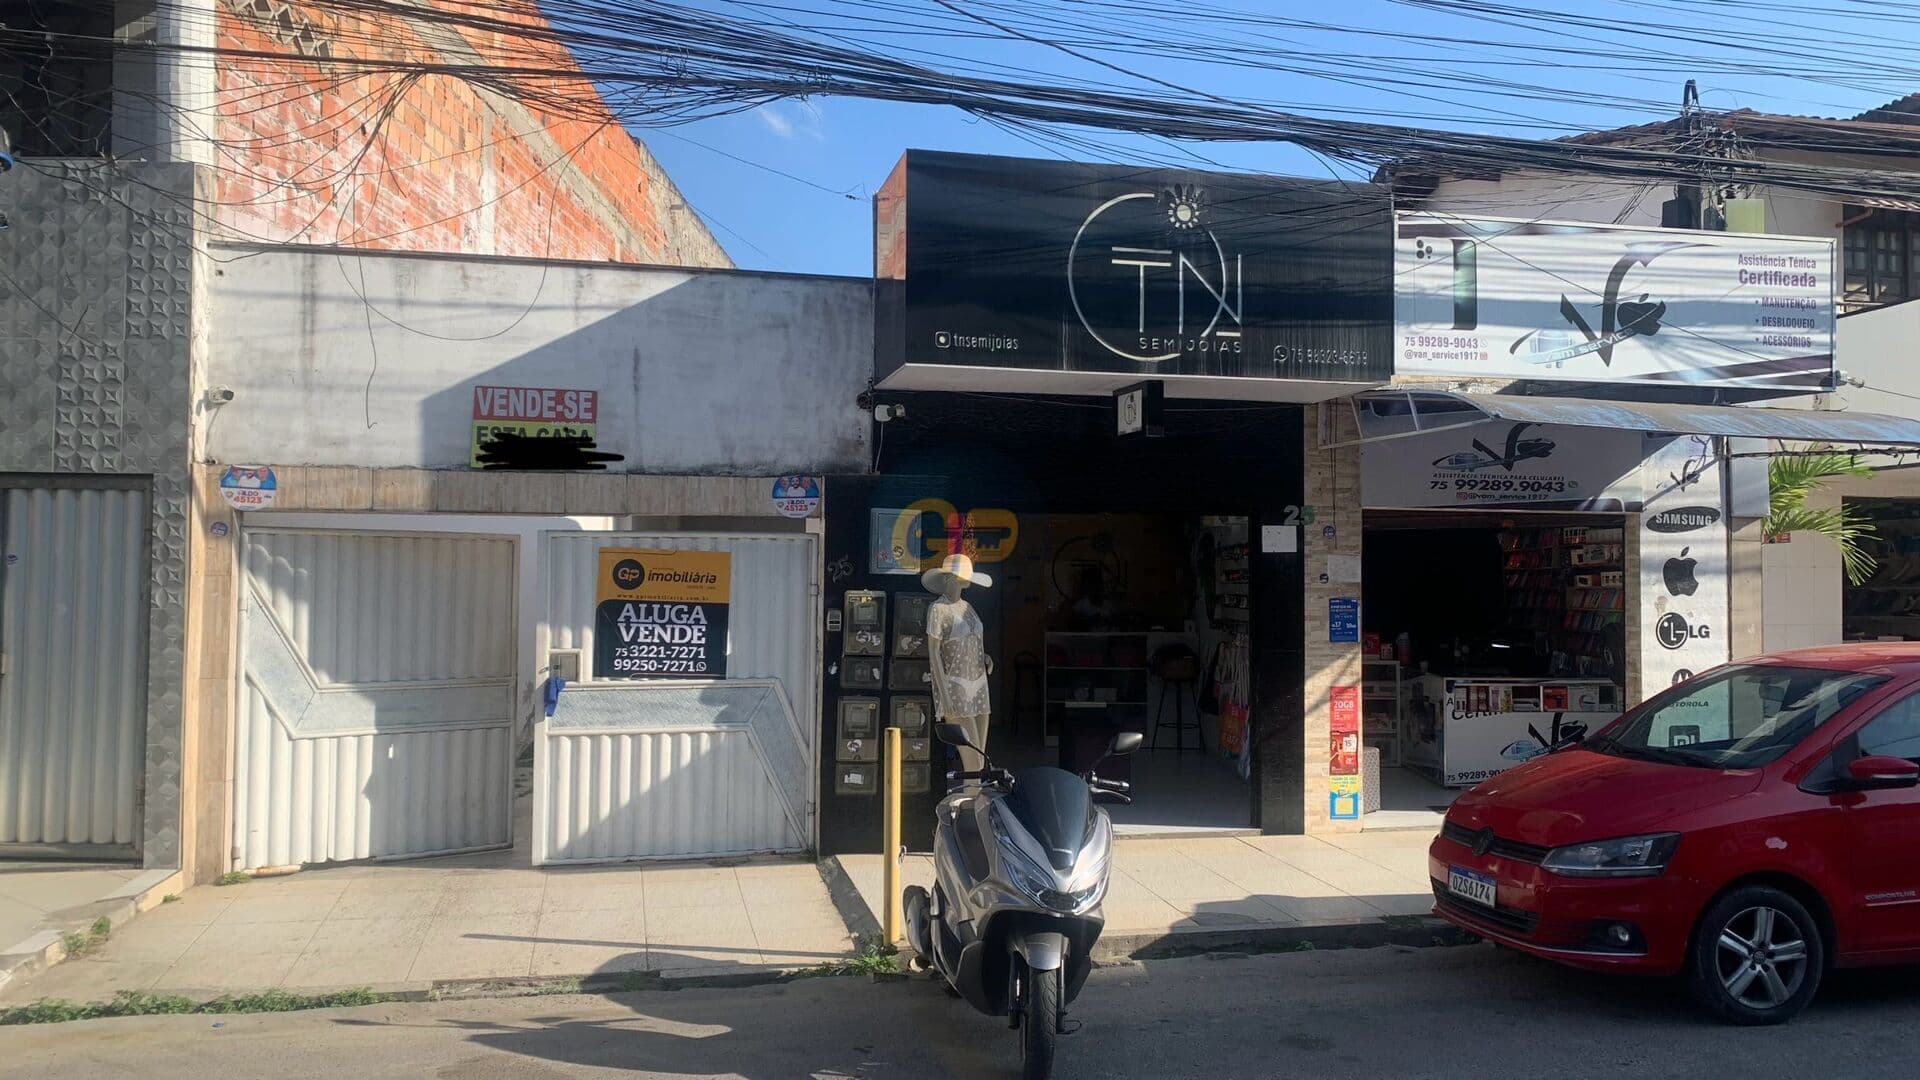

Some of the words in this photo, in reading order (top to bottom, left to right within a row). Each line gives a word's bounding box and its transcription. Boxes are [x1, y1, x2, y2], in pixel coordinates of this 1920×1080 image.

[1739, 268, 1817, 288] Certificada
[1761, 315, 1815, 329] DESBLOQUEIO
[953, 333, 1019, 351] tnsemijoias
[1404, 336, 1416, 347] 75
[1418, 335, 1478, 349] 99289-9043
[476, 387, 593, 420] VENDE-SE
[1430, 481, 1449, 490] 75
[1455, 479, 1565, 493] 99289.9043
[1655, 513, 1712, 527] SAMSUNG
[647, 569, 718, 584] imobiliária
[617, 602, 708, 625] ALUGA
[617, 622, 706, 644] VENDE
[615, 647, 628, 657] 75
[629, 645, 706, 659] 3221-7271
[613, 658, 695, 672] 99250-7271
